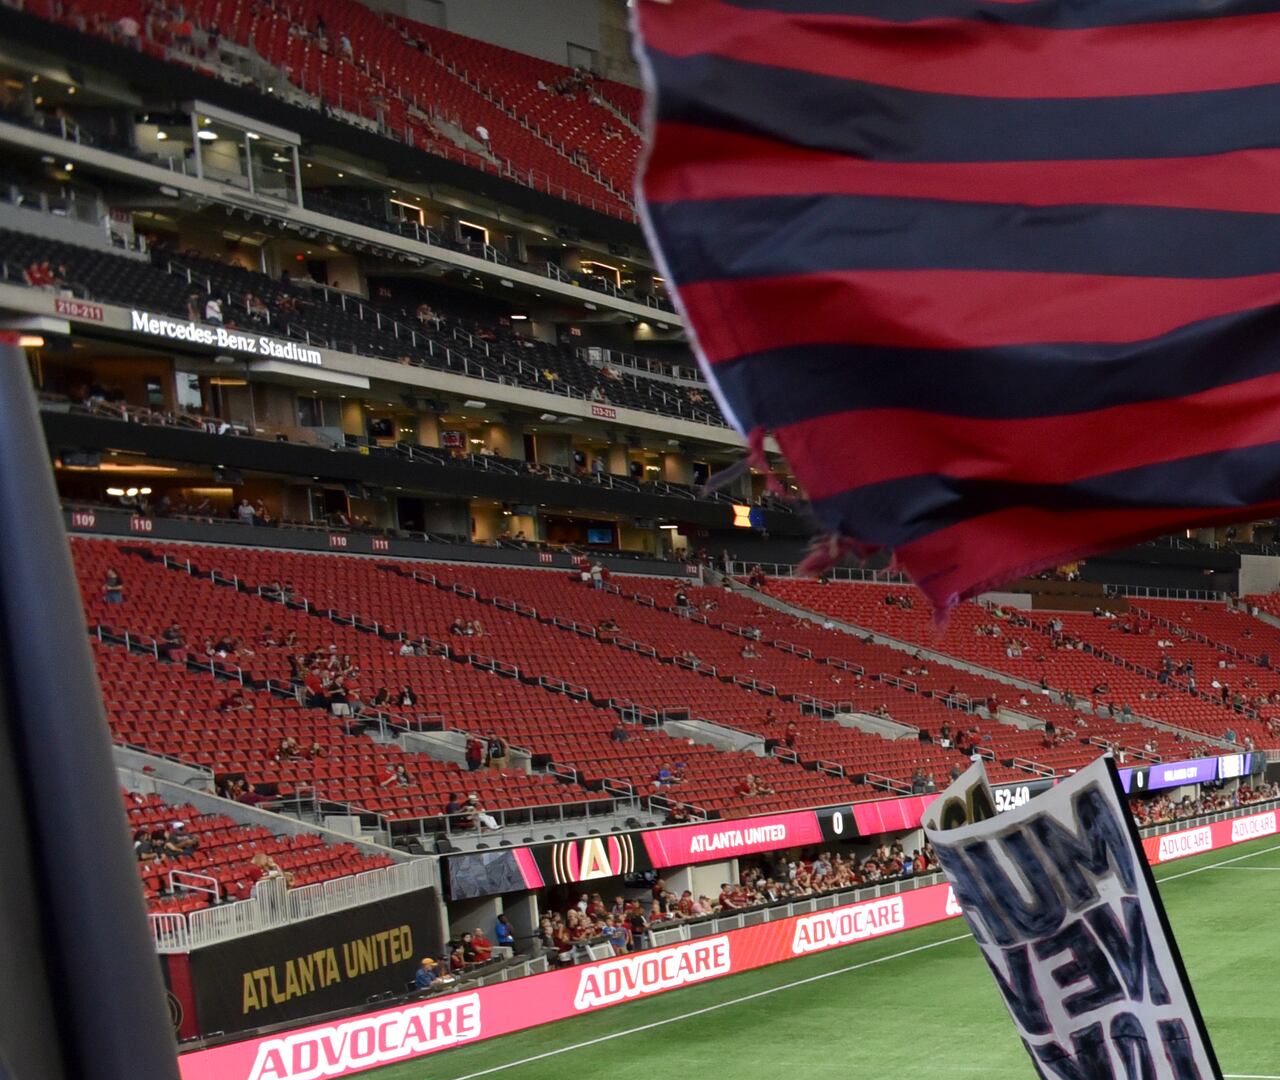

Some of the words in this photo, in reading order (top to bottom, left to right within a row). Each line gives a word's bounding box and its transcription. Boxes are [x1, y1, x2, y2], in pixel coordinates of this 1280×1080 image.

[57, 301, 101, 319] 210-211
[131, 310, 256, 352] Mercedes-Benz
[258, 336, 323, 366] Stadium
[76, 514, 95, 527] 109
[133, 519, 152, 531] 110
[332, 536, 347, 547] 110
[375, 539, 389, 550] 111
[1136, 771, 1144, 789] 0
[993, 785, 1030, 812] 52:40
[832, 811, 844, 835] 0
[1232, 812, 1275, 842] ADVOCARE
[690, 827, 743, 853] ATLANTA
[745, 824, 785, 848] UNITED
[1161, 828, 1212, 859] ADVOCARE
[795, 898, 904, 950] ADVOCARE
[242, 944, 342, 1014] ATLANTA
[344, 924, 414, 979] UNITED
[577, 937, 729, 1008] ADVOCARE
